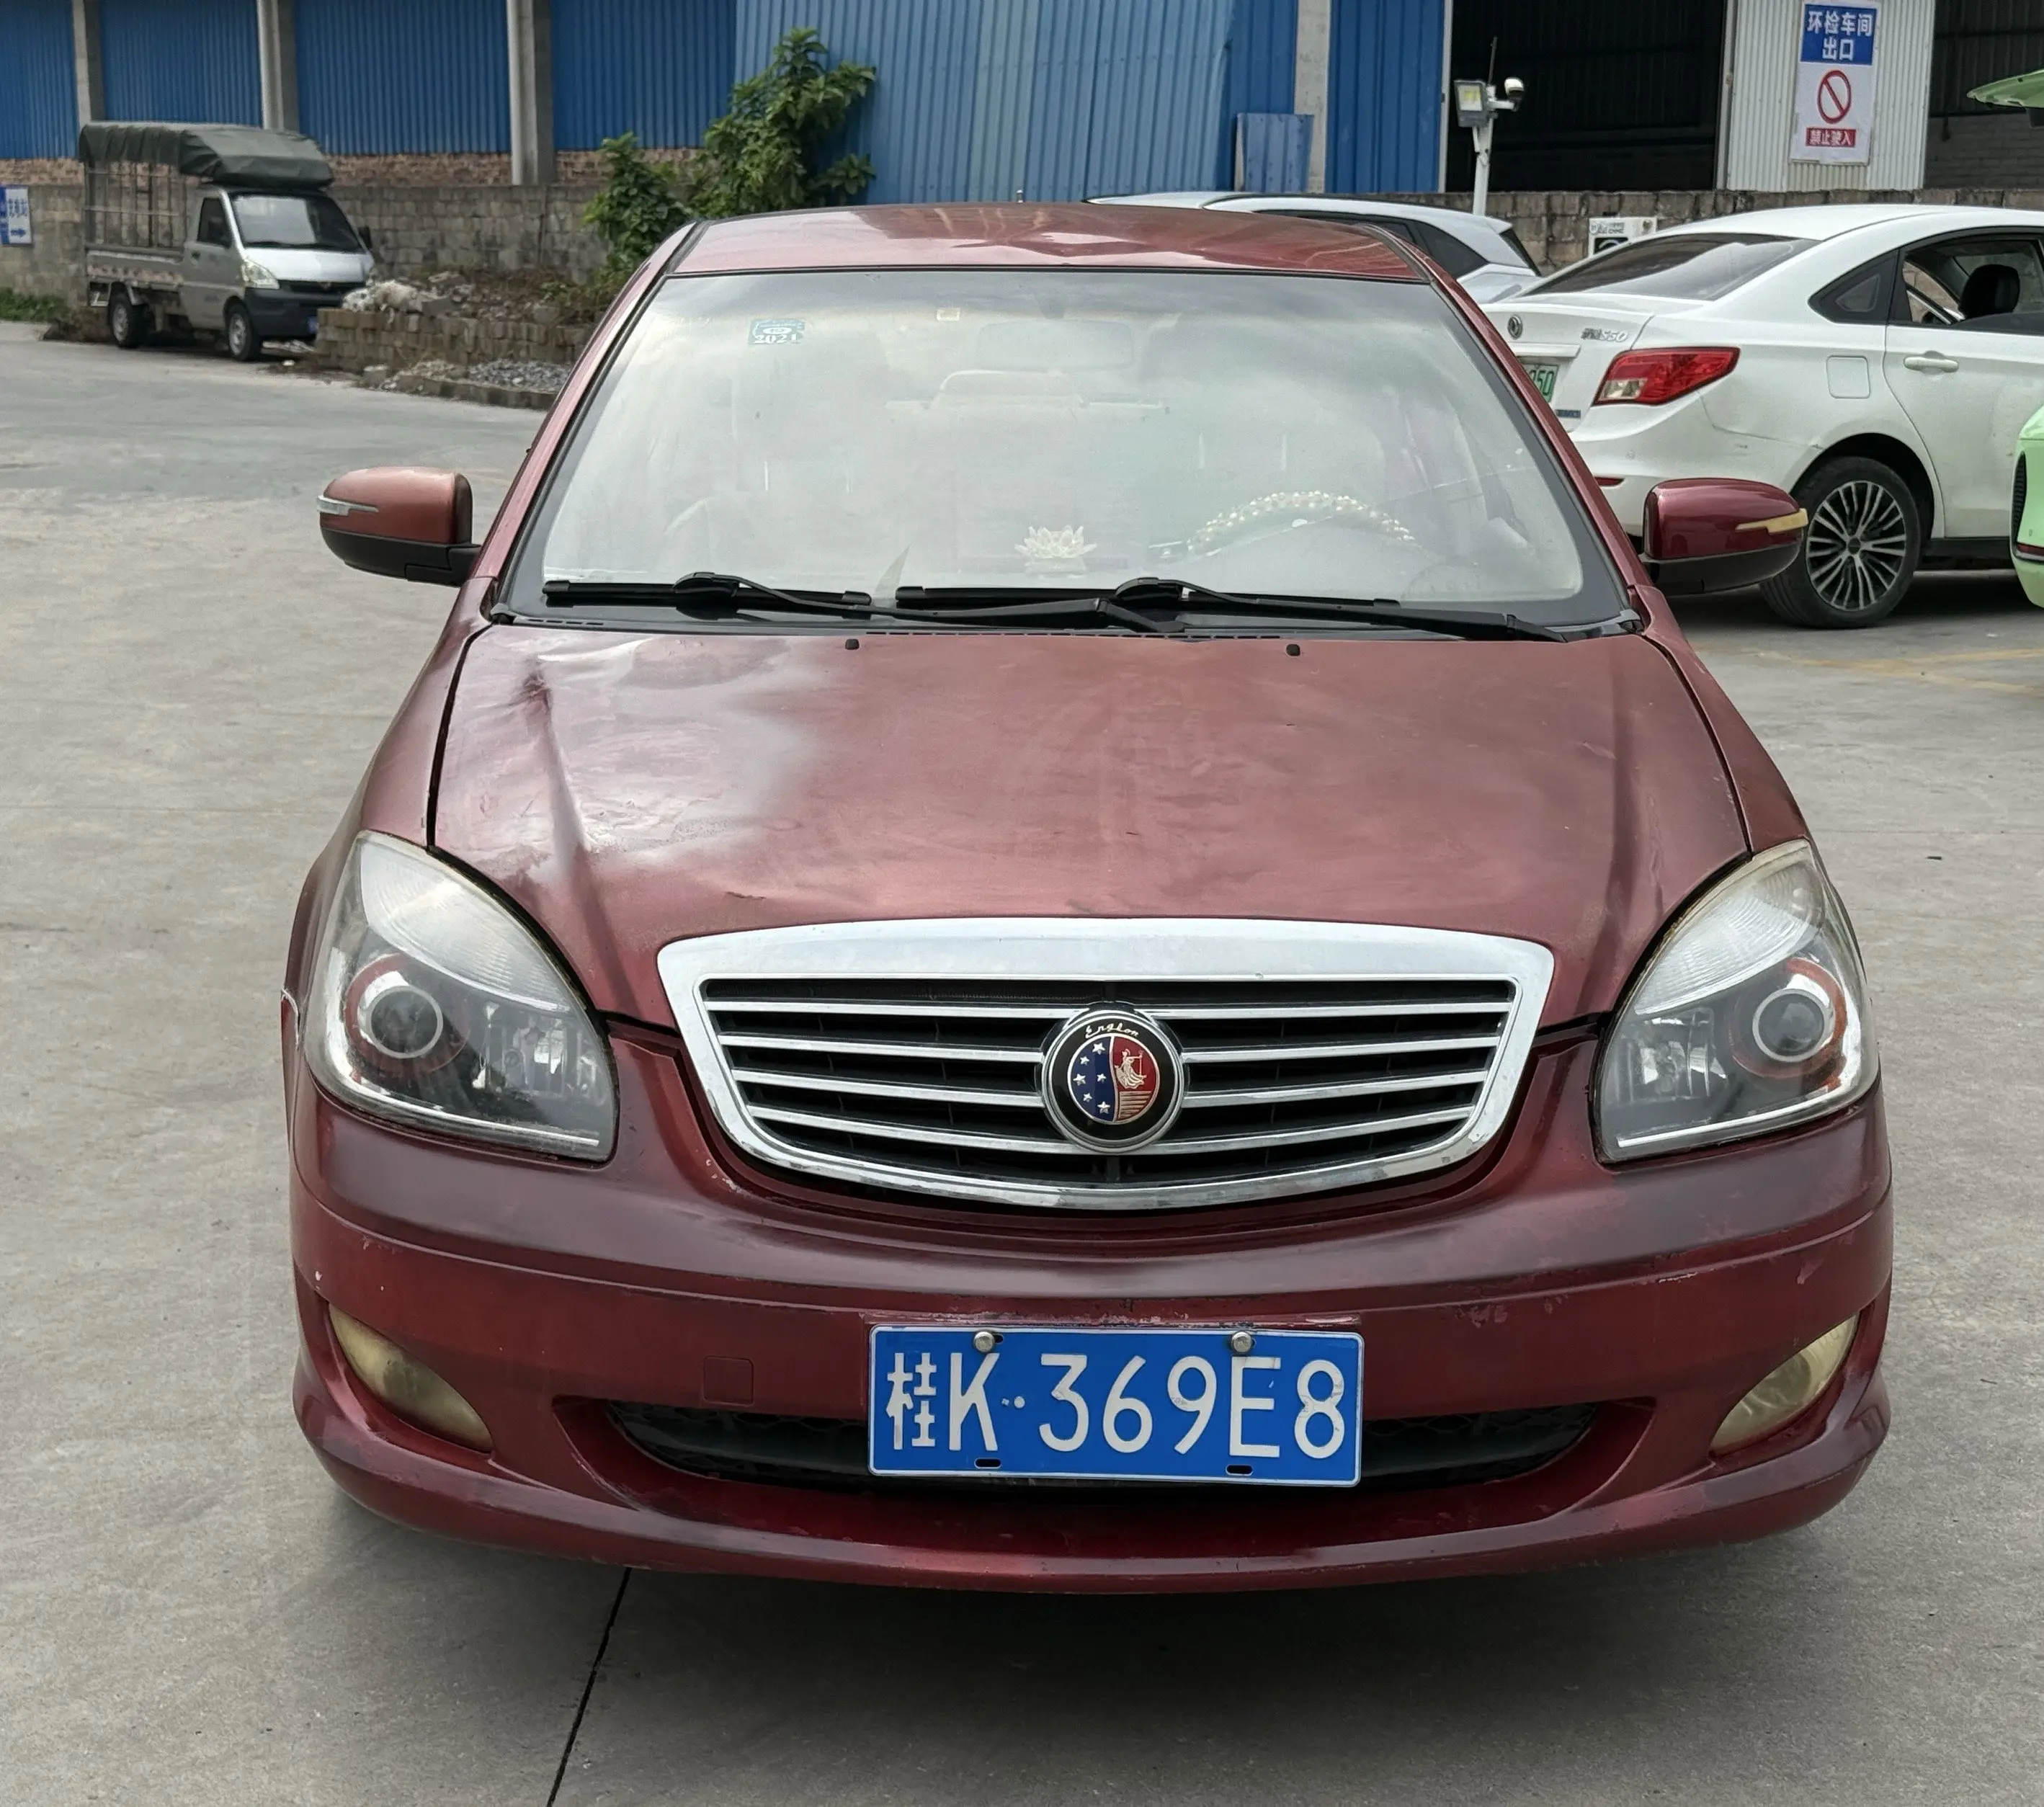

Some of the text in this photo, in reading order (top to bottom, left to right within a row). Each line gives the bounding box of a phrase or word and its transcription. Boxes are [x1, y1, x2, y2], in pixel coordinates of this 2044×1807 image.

[1806, 10, 1873, 37] 环检车间
[1821, 37, 1855, 61] 出口
[1085, 1022, 1139, 1039] Englon
